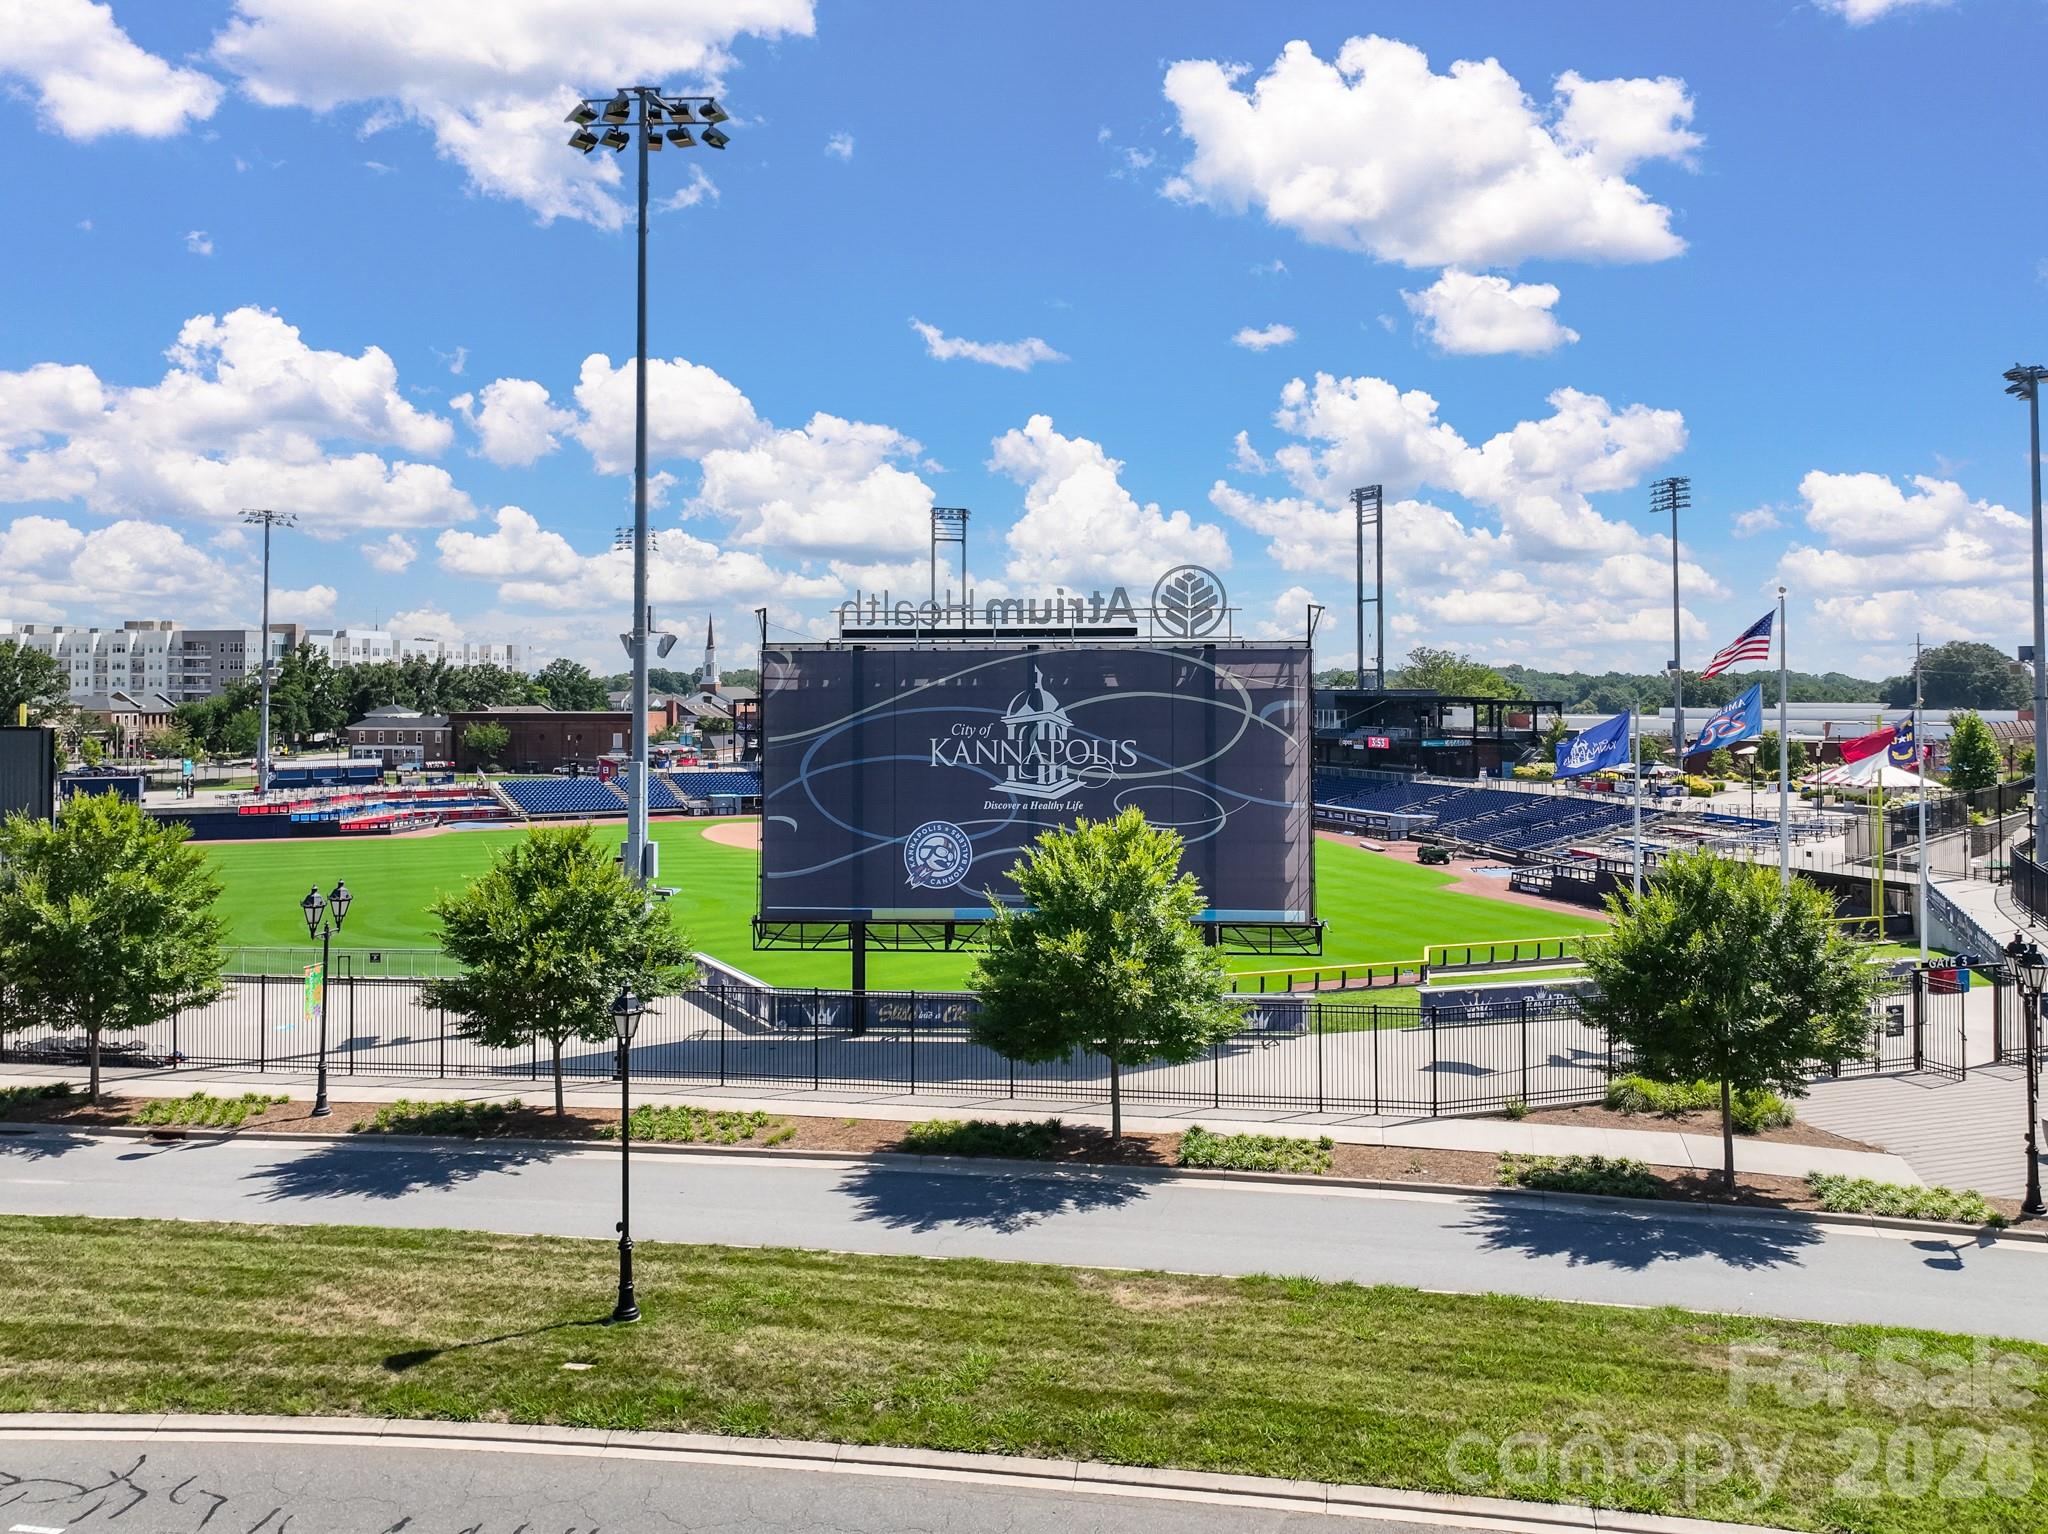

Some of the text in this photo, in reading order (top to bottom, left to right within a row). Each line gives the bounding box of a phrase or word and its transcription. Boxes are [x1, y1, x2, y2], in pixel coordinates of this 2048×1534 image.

[951, 722, 994, 738] City of
[929, 738, 1138, 767] KANNAPOLIS
[983, 801, 1022, 811] Discover
[1030, 801, 1064, 812] Healthy
[1066, 801, 1084, 811] Life
[907, 824, 942, 869] KANNAPOLIS
[930, 829, 969, 886] CANNON BALLERS
[1928, 956, 1968, 969] GATE 3
